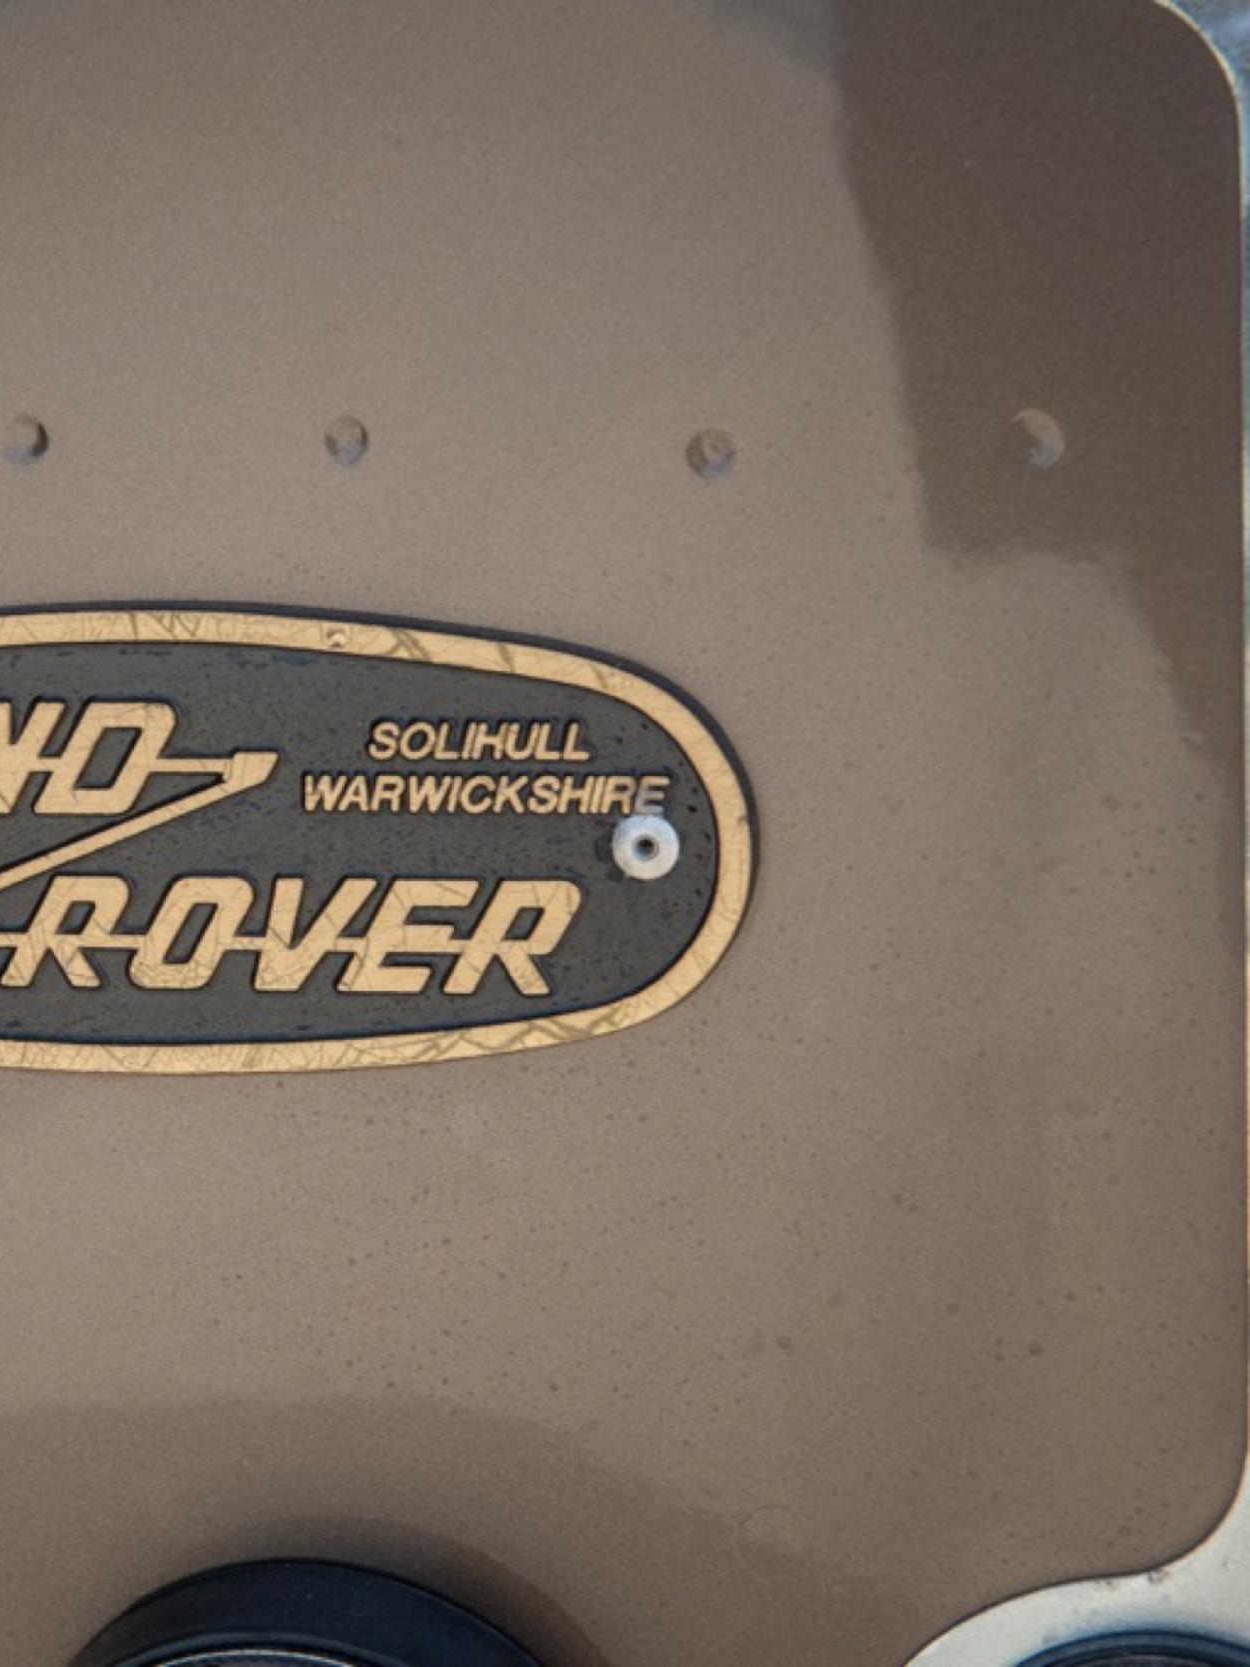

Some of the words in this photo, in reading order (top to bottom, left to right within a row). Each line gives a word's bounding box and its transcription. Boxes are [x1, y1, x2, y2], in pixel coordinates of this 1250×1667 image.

[368, 721, 590, 761] SOLIHULL
[303, 774, 671, 815] WARWICKSHIRE
[0, 876, 582, 995] ROVER
